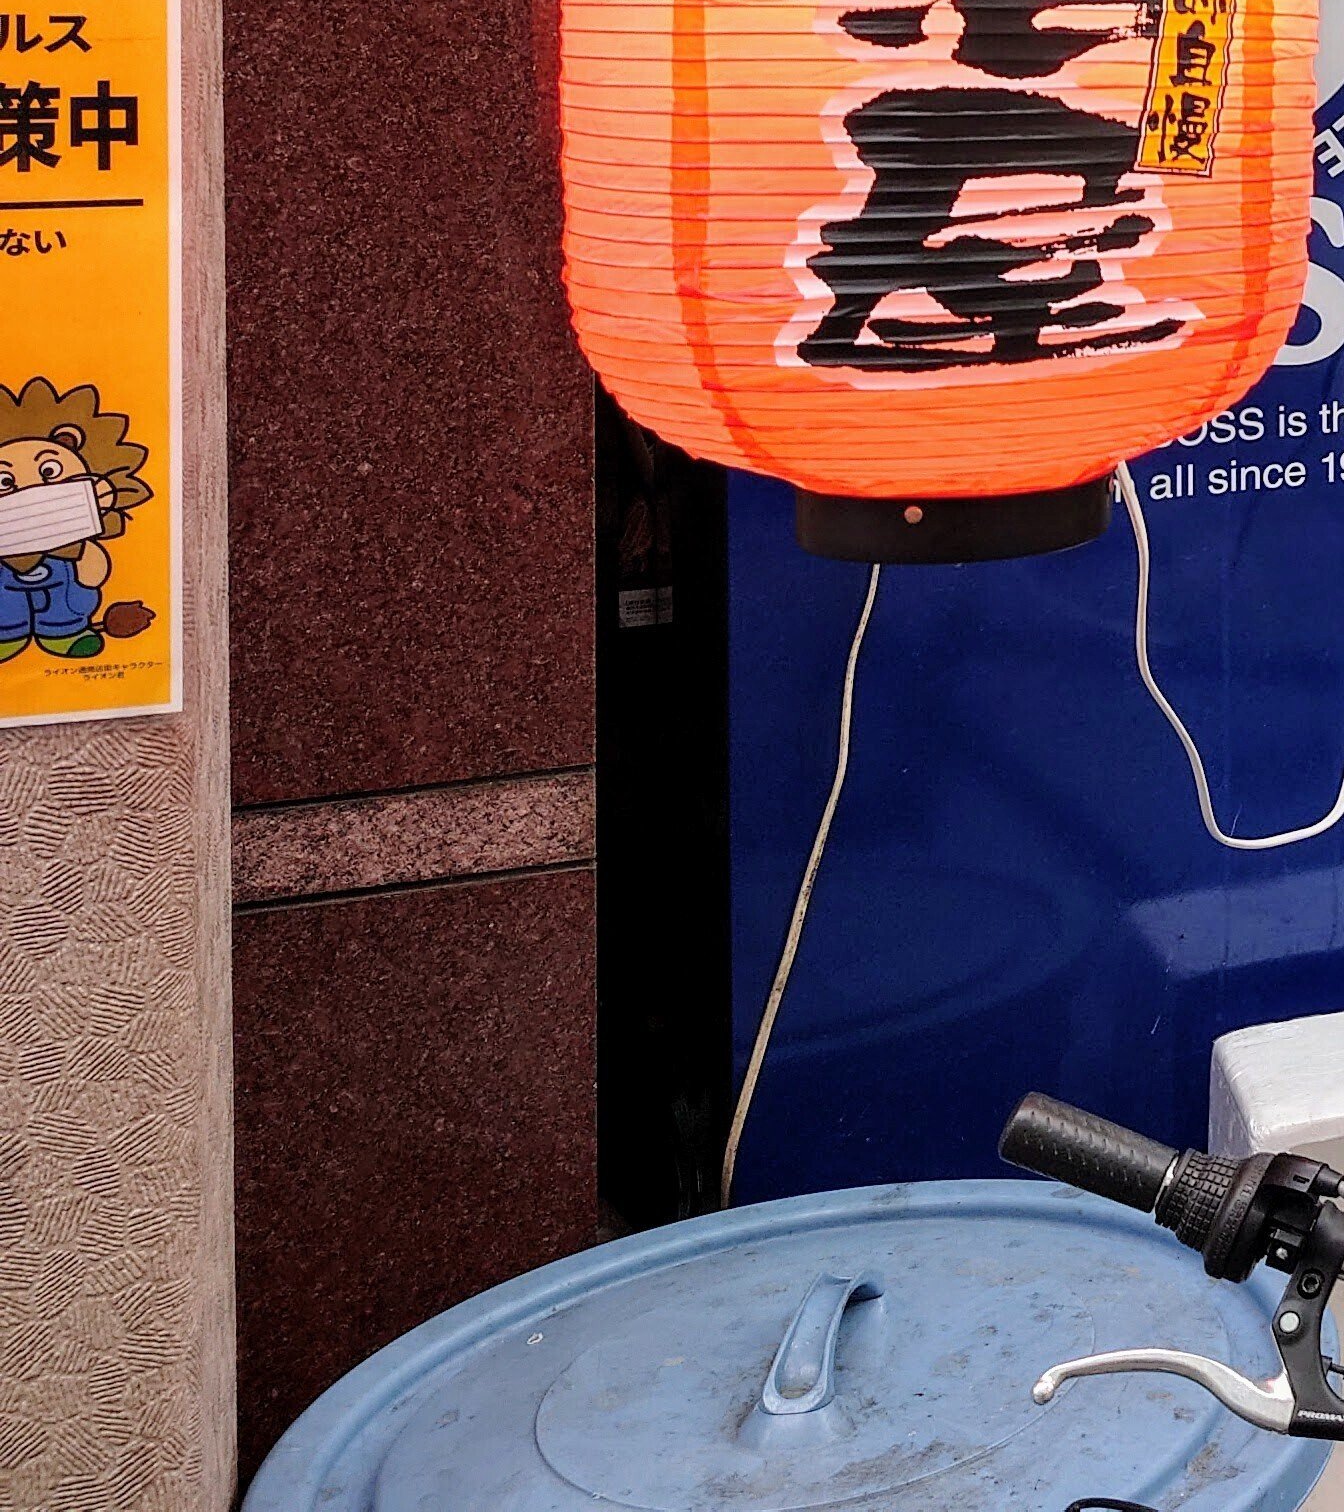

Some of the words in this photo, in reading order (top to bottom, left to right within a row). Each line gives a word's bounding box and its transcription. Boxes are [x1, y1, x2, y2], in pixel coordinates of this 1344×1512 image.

[1278, 405, 1308, 437] is
[1149, 464, 1194, 500] all
[1207, 459, 1307, 494] since
